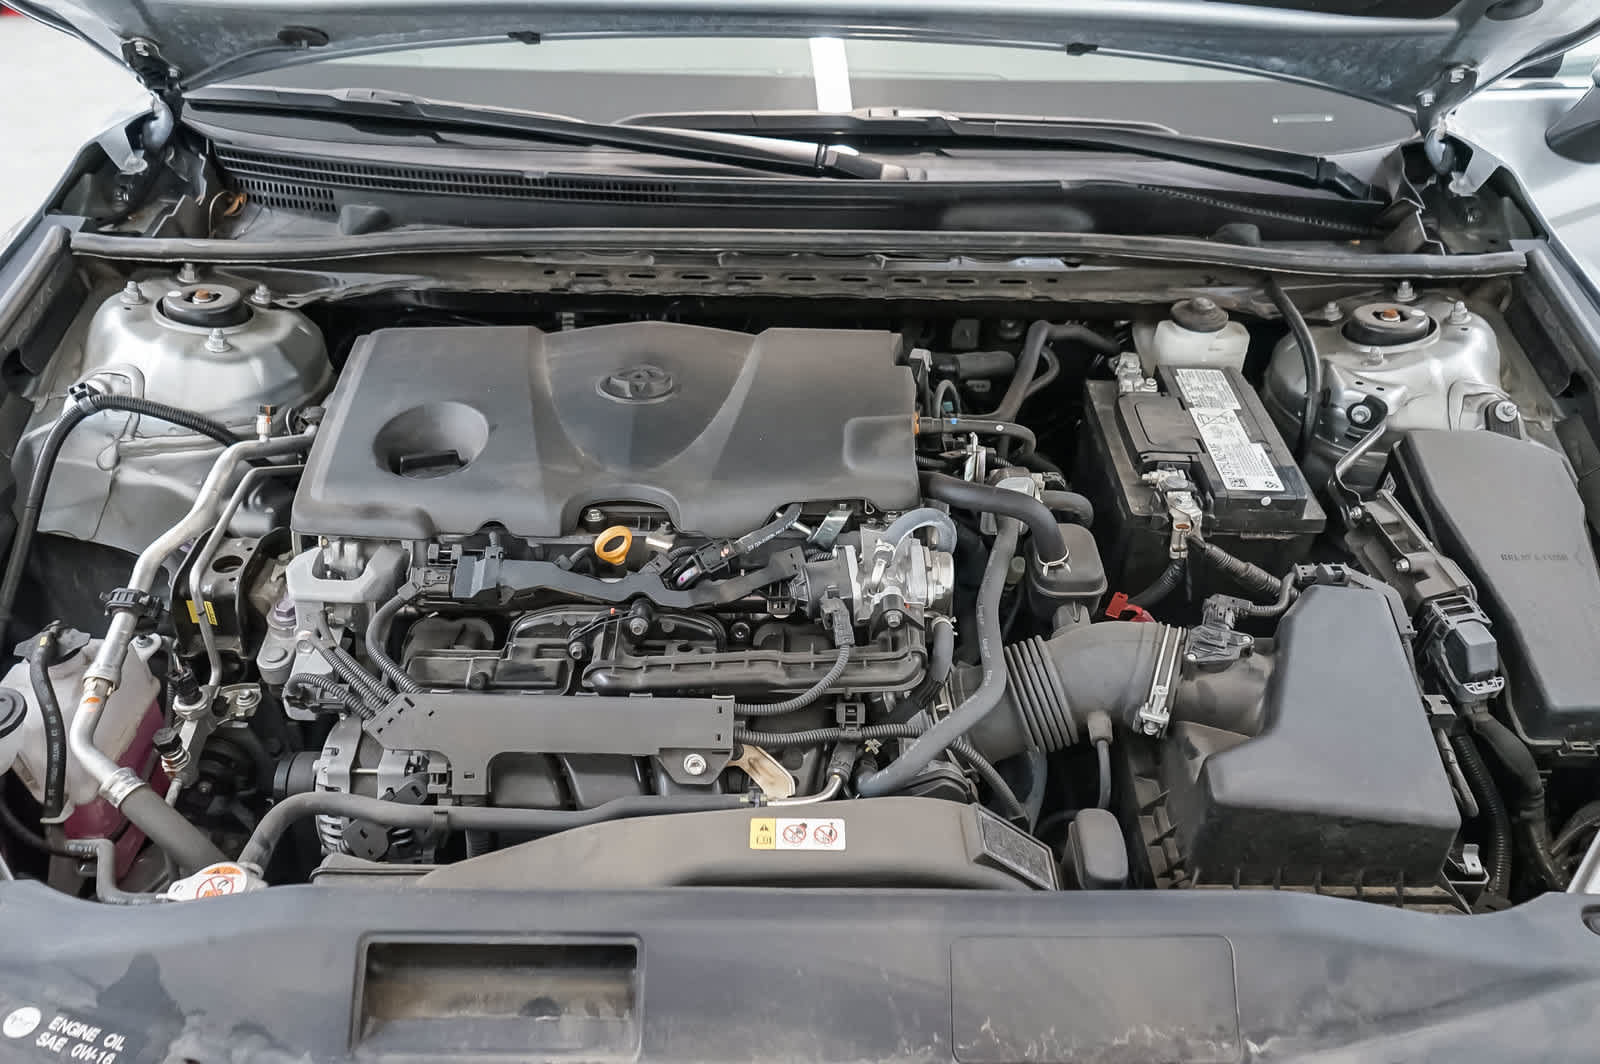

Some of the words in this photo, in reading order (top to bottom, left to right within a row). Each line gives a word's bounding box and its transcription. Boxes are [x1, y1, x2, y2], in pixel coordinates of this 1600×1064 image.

[36, 1031, 68, 1053] SAE
[48, 1016, 102, 1042] ENGINE
[103, 1033, 126, 1051] OIL
